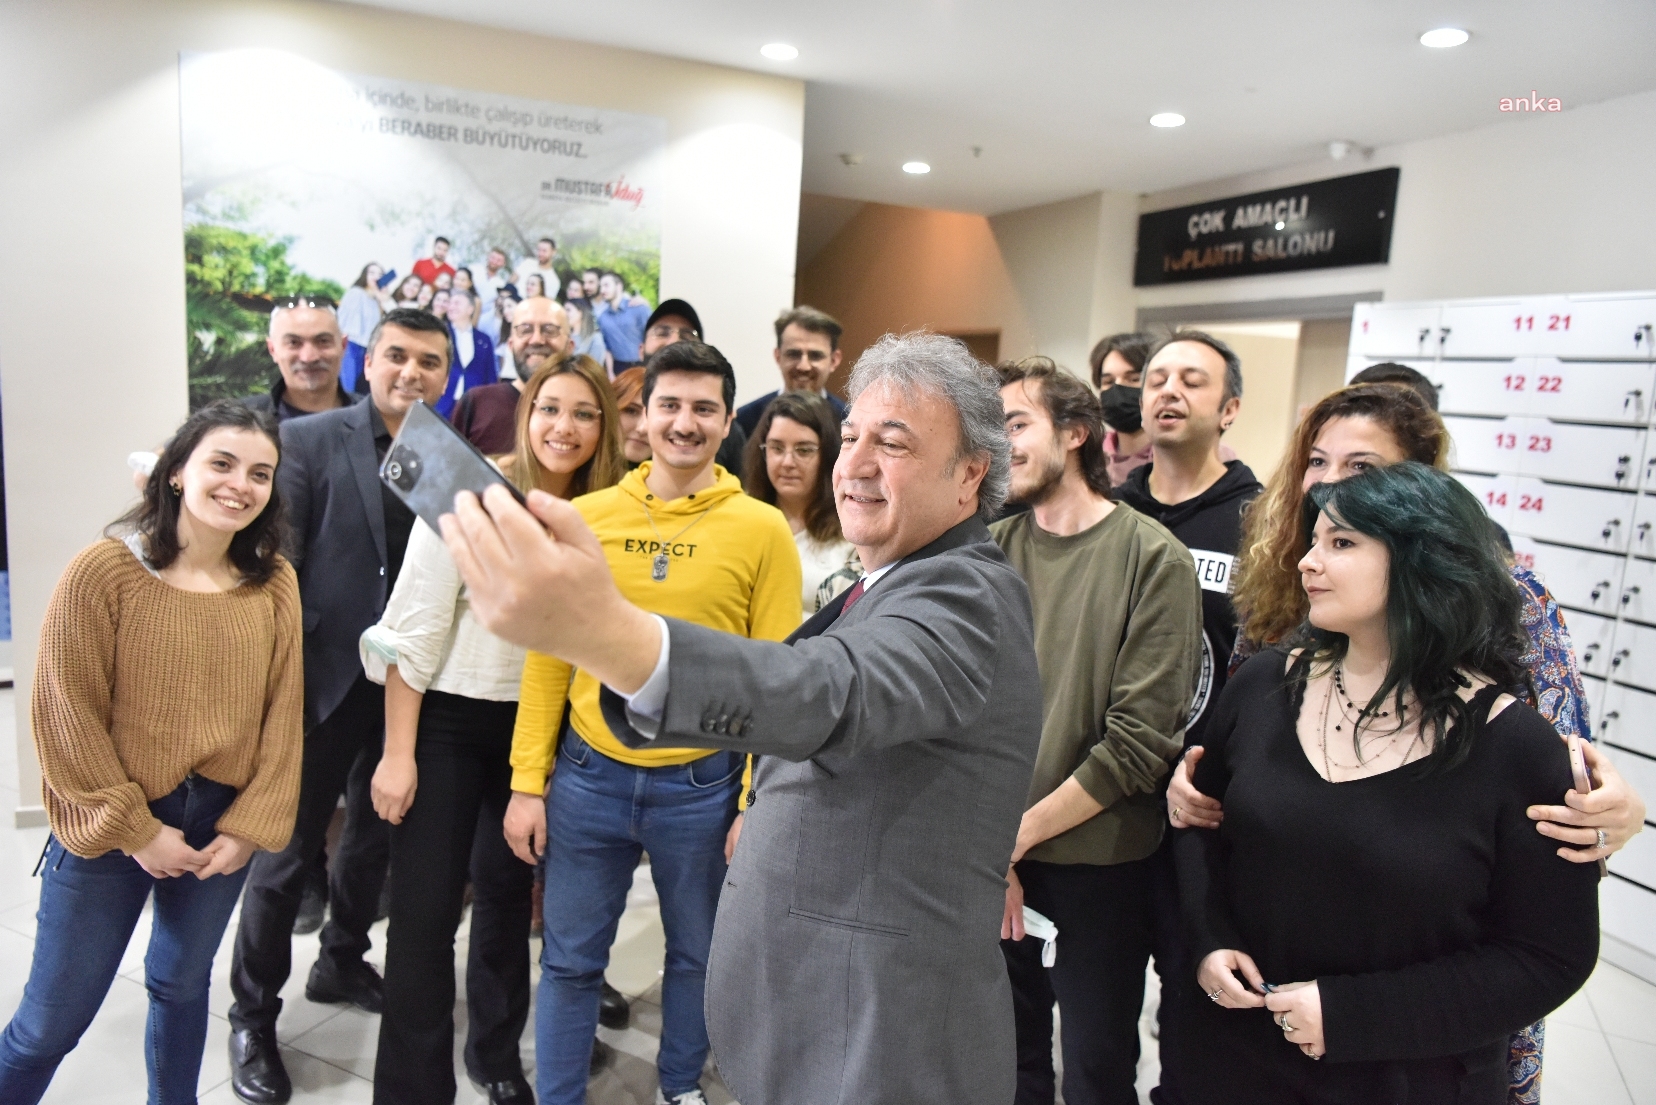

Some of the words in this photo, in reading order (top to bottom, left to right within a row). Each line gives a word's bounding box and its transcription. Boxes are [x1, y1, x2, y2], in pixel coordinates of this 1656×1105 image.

[424, 94, 481, 120] birlikte
[484, 105, 534, 128] çalışıp
[537, 111, 604, 135] üreterek
[379, 116, 460, 143] BERABER
[463, 125, 588, 158] BÜYÜTÜYORUZ.
[1188, 209, 1226, 241] ÇOK
[1232, 195, 1309, 230] AMAÇLI
[1251, 229, 1335, 261] SALONU
[1361, 320, 1370, 334] 1
[1513, 315, 1535, 332] 11
[1547, 314, 1573, 332] 21
[1503, 374, 1526, 392] 12
[1536, 375, 1563, 393] 22
[1495, 433, 1517, 450] 13
[1527, 435, 1553, 453] 23
[1486, 491, 1508, 508] 14
[1519, 494, 1544, 513] 24
[624, 538, 698, 558] EXPECT
